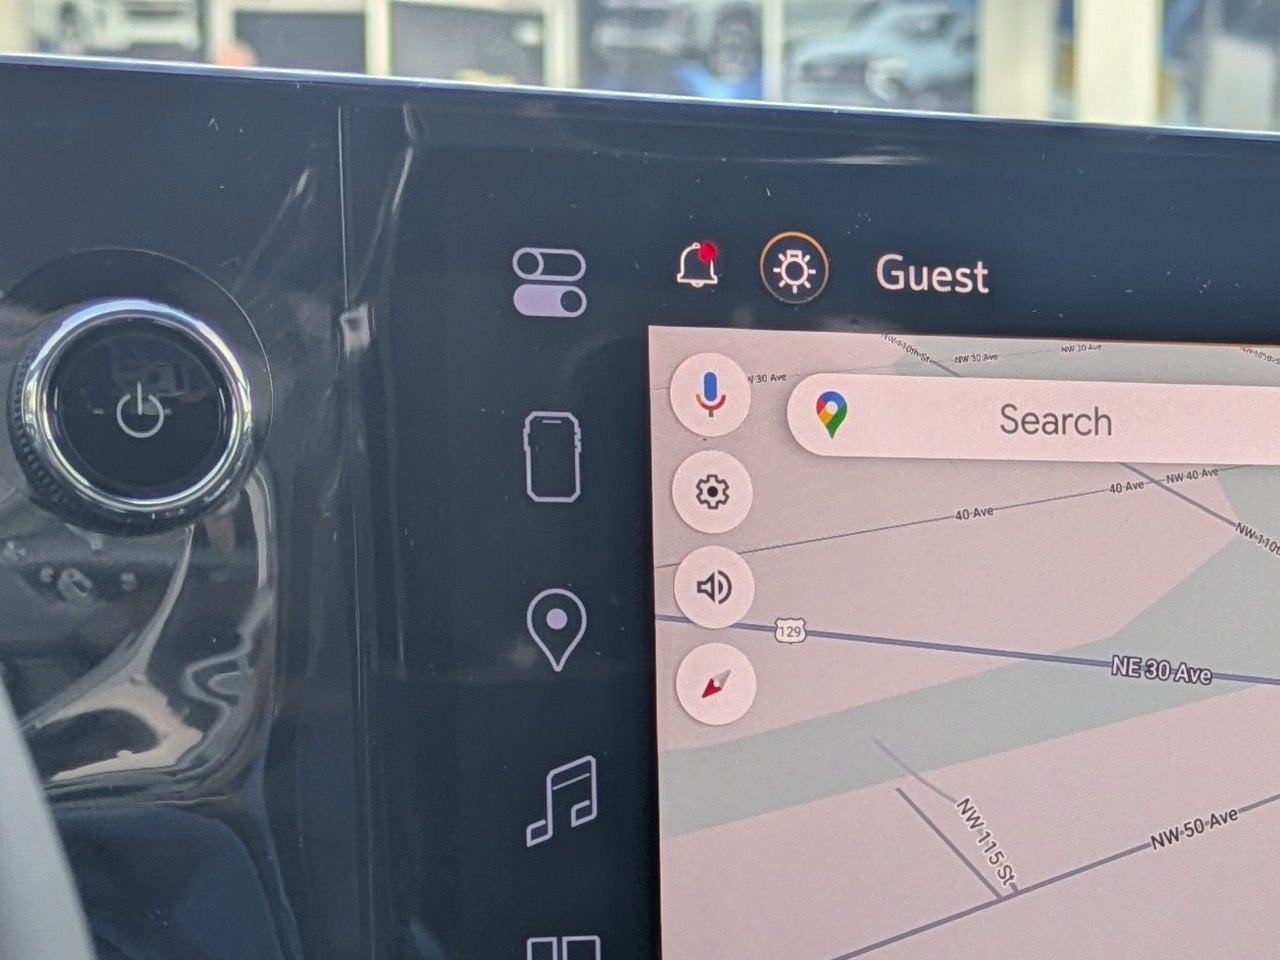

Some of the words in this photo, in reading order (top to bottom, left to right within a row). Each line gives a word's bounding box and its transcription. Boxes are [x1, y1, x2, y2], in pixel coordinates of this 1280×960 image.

[877, 253, 989, 294] Guest
[756, 373, 768, 383] 30
[770, 373, 787, 382] Ave
[1000, 403, 1112, 436] Search
[1166, 472, 1184, 483] NW
[1185, 470, 1199, 481] 40
[1201, 467, 1219, 478] Ave
[1109, 483, 1124, 493] 40
[1125, 480, 1144, 491] Ave
[955, 509, 970, 520] 40
[972, 507, 994, 519] Ave
[1235, 522, 1256, 540] NW
[778, 625, 802, 638] 129
[1111, 655, 1142, 677] NE
[1145, 658, 1171, 680] 30
[1173, 662, 1212, 685] Ave
[1150, 829, 1181, 850] NW
[1183, 819, 1205, 841] 50
[1208, 807, 1239, 831] Ave
[955, 798, 985, 834] NW
[978, 828, 1005, 866] 115
[996, 863, 1017, 887] St
